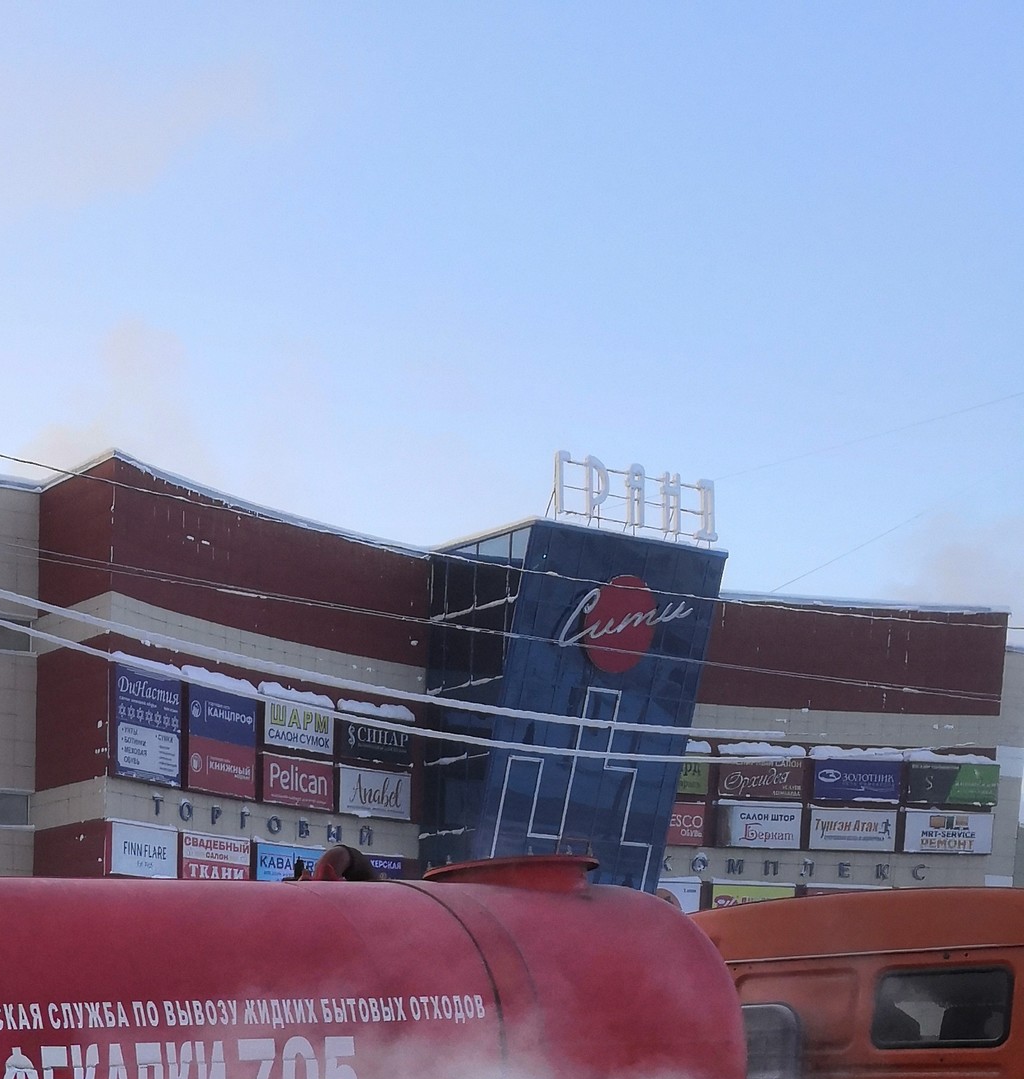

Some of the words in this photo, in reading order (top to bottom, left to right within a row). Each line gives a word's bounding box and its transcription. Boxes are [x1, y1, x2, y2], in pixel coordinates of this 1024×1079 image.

[554, 450, 718, 542] ГРАНД
[559, 588, 693, 647] Сити
[207, 706, 253, 725] КАНЦПРОФ
[270, 703, 329, 735] ШАРМ
[268, 728, 299, 743] САЛОН
[299, 733, 330, 749] СУМОК
[209, 760, 251, 776] КНИЖНЫЙ
[842, 772, 895, 783] ЗОЛОТНИК
[269, 762, 328, 796] Pelican
[724, 767, 792, 795] Орхидея
[349, 773, 403, 808] Anabel
[739, 812, 769, 821] САЛОН
[771, 813, 795, 821] ШТОР
[739, 823, 794, 842] Беркат
[921, 830, 976, 839] MRT-SERVICE
[123, 841, 143, 857] FINN
[144, 844, 167, 860] FLARE
[184, 836, 250, 854] СВАДЕБНЫЙ
[921, 838, 975, 850] РЕМОНТ
[205, 852, 229, 861] САЛОН
[189, 863, 244, 880] ТКАНИ
[48, 1001, 130, 1029] СЛУЖБА
[132, 1001, 160, 1027] ПО
[164, 1000, 238, 1027] ВЫВОЗУ
[244, 999, 319, 1029] ЖИДКИХ
[320, 997, 407, 1024] БЫТОВЫХ
[410, 994, 486, 1024] ОТХОДОВ
